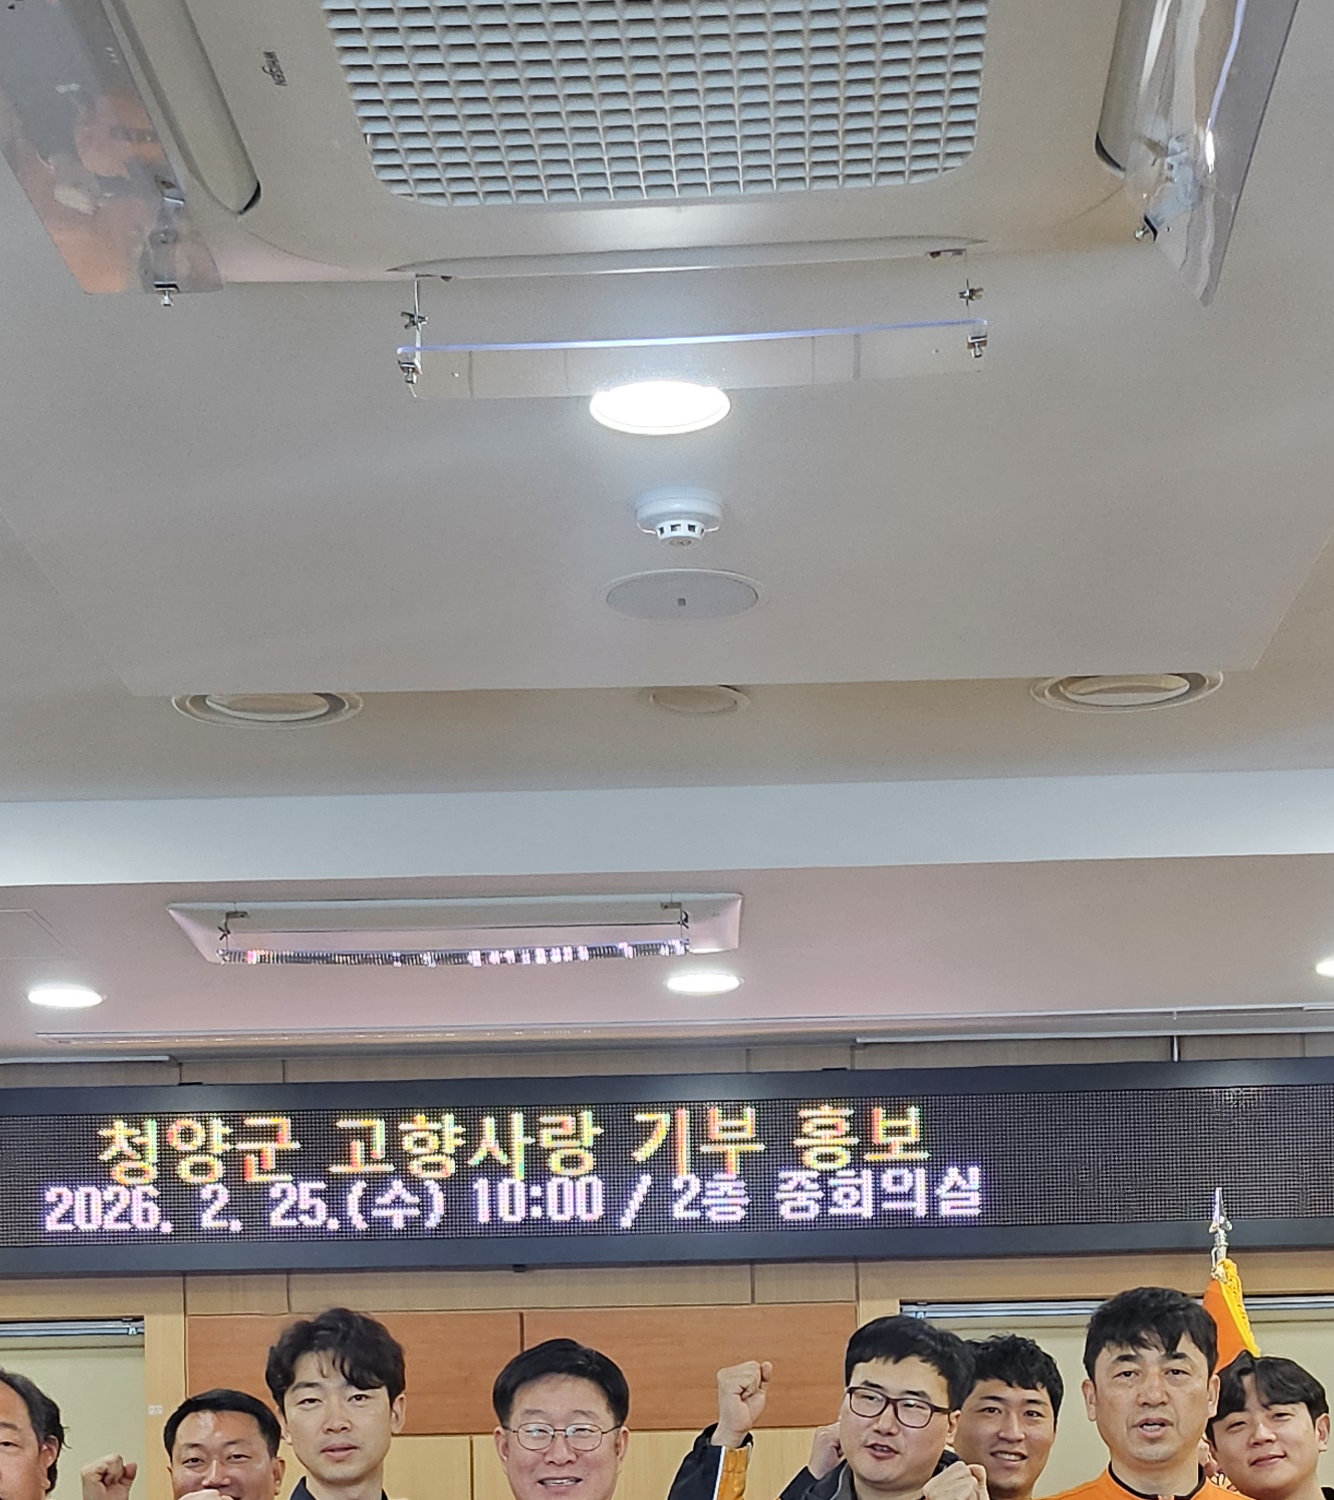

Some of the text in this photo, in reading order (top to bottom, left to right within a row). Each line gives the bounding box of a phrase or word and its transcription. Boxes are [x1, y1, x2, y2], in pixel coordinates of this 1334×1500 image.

[98, 1104, 932, 1186] 청양군 고향사랑 기부 홍보
[43, 1184, 174, 1234] 2026.
[199, 1182, 244, 1233] 2.
[471, 1174, 604, 1224] 10:00
[672, 1172, 752, 1222] 2층
[774, 1164, 985, 1222] 중회의실
